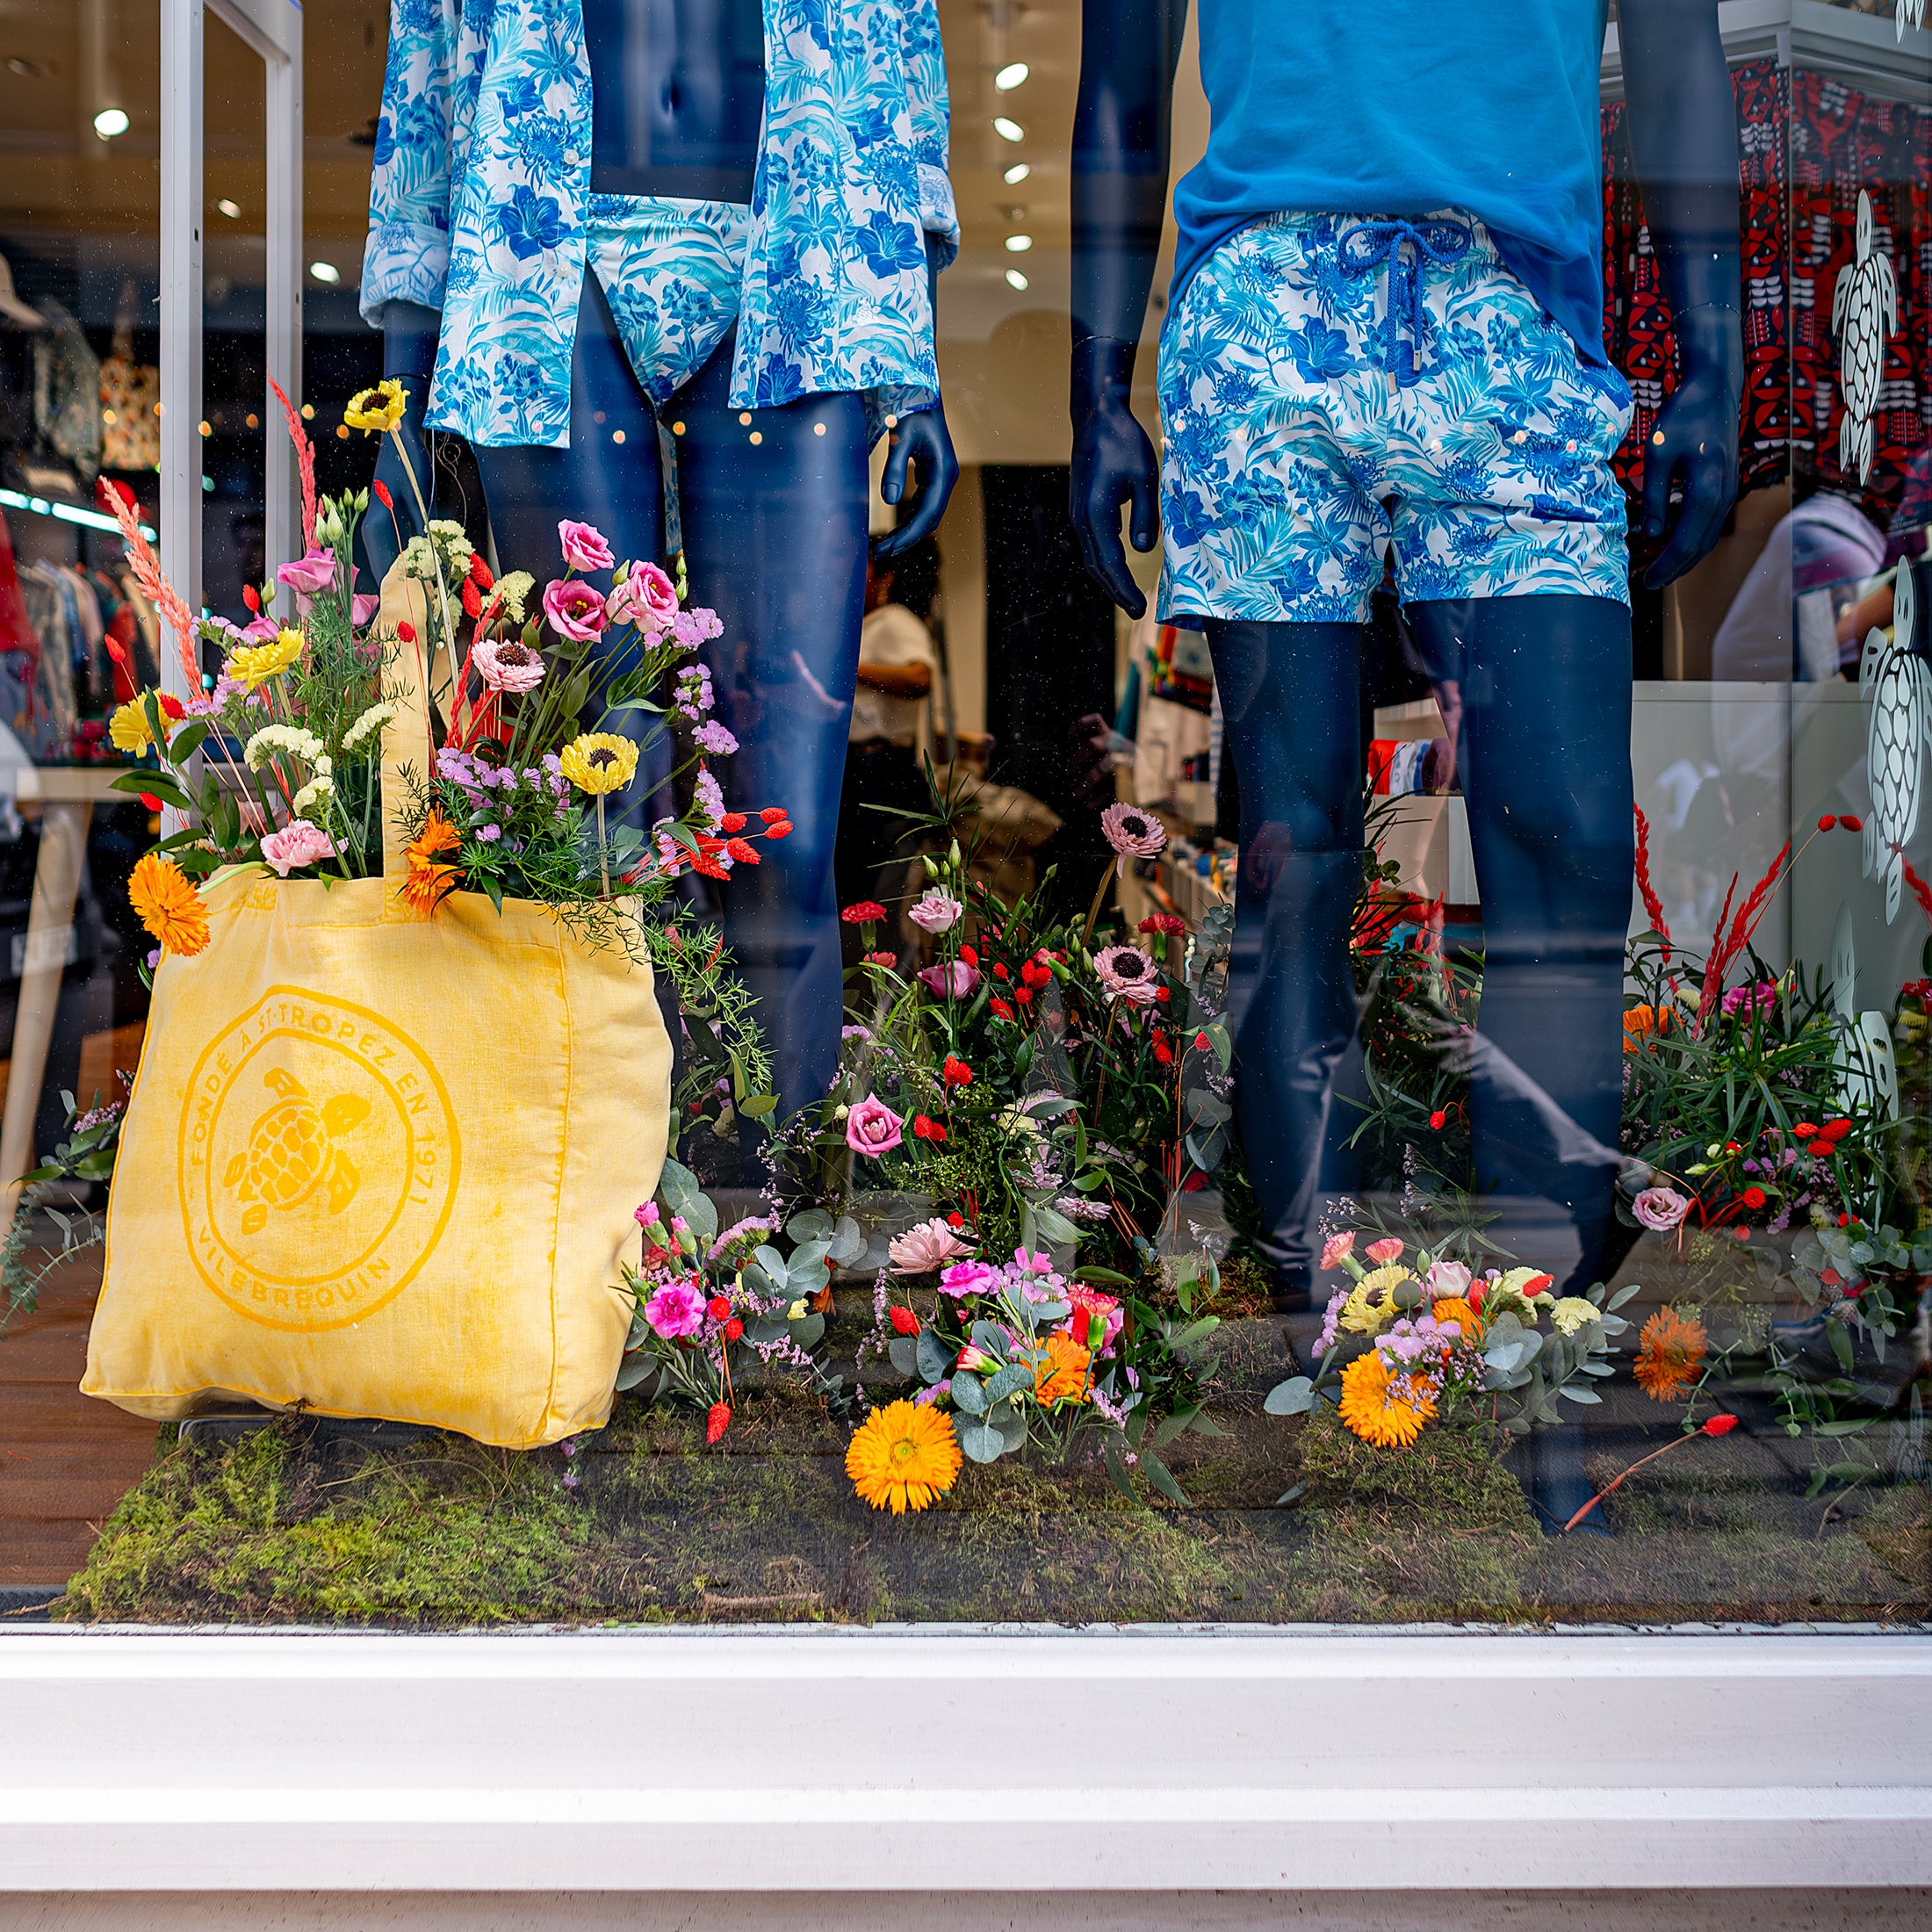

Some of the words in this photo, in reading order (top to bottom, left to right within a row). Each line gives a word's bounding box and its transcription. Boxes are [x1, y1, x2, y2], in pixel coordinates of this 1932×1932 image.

[190, 1052, 234, 1167] FONDÉ
[395, 1071, 429, 1115] EN
[408, 1128, 437, 1206] 1971
[198, 1224, 392, 1310] VILEBREQUIN
